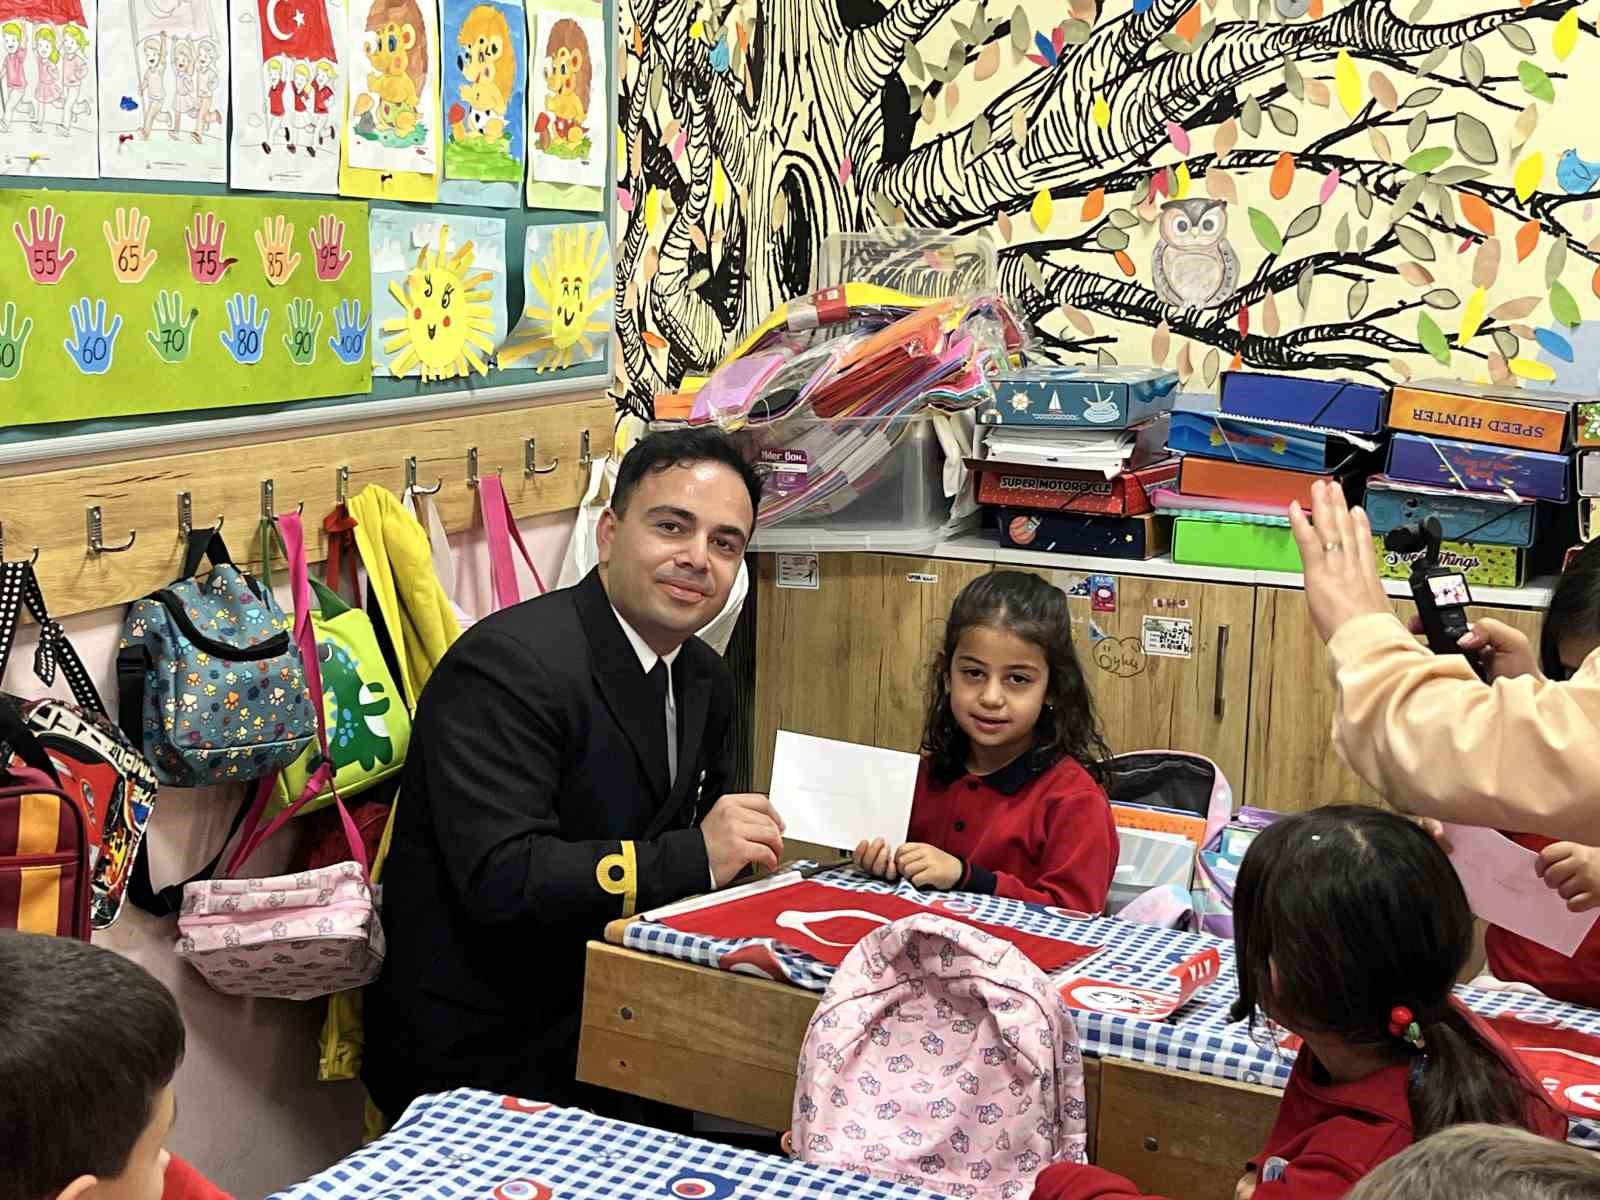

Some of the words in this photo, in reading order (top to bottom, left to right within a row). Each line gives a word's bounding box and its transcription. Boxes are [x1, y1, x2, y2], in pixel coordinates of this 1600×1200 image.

[34, 250, 56, 275] 55
[118, 245, 139, 272] 65
[195, 250, 217, 276] 75
[266, 252, 284, 277] 85
[321, 246, 337, 272] 95
[0, 343, 15, 368] 0
[82, 337, 107, 364] 60
[160, 329, 185, 353] 70
[237, 328, 258, 356] 80
[294, 330, 312, 356] 90
[340, 334, 362, 354] 100
[1412, 408, 1482, 429] HUNTER
[1487, 420, 1544, 438] SPEED
[1000, 477, 1037, 489] SUPER
[1038, 479, 1113, 495] MOTORCYCLE
